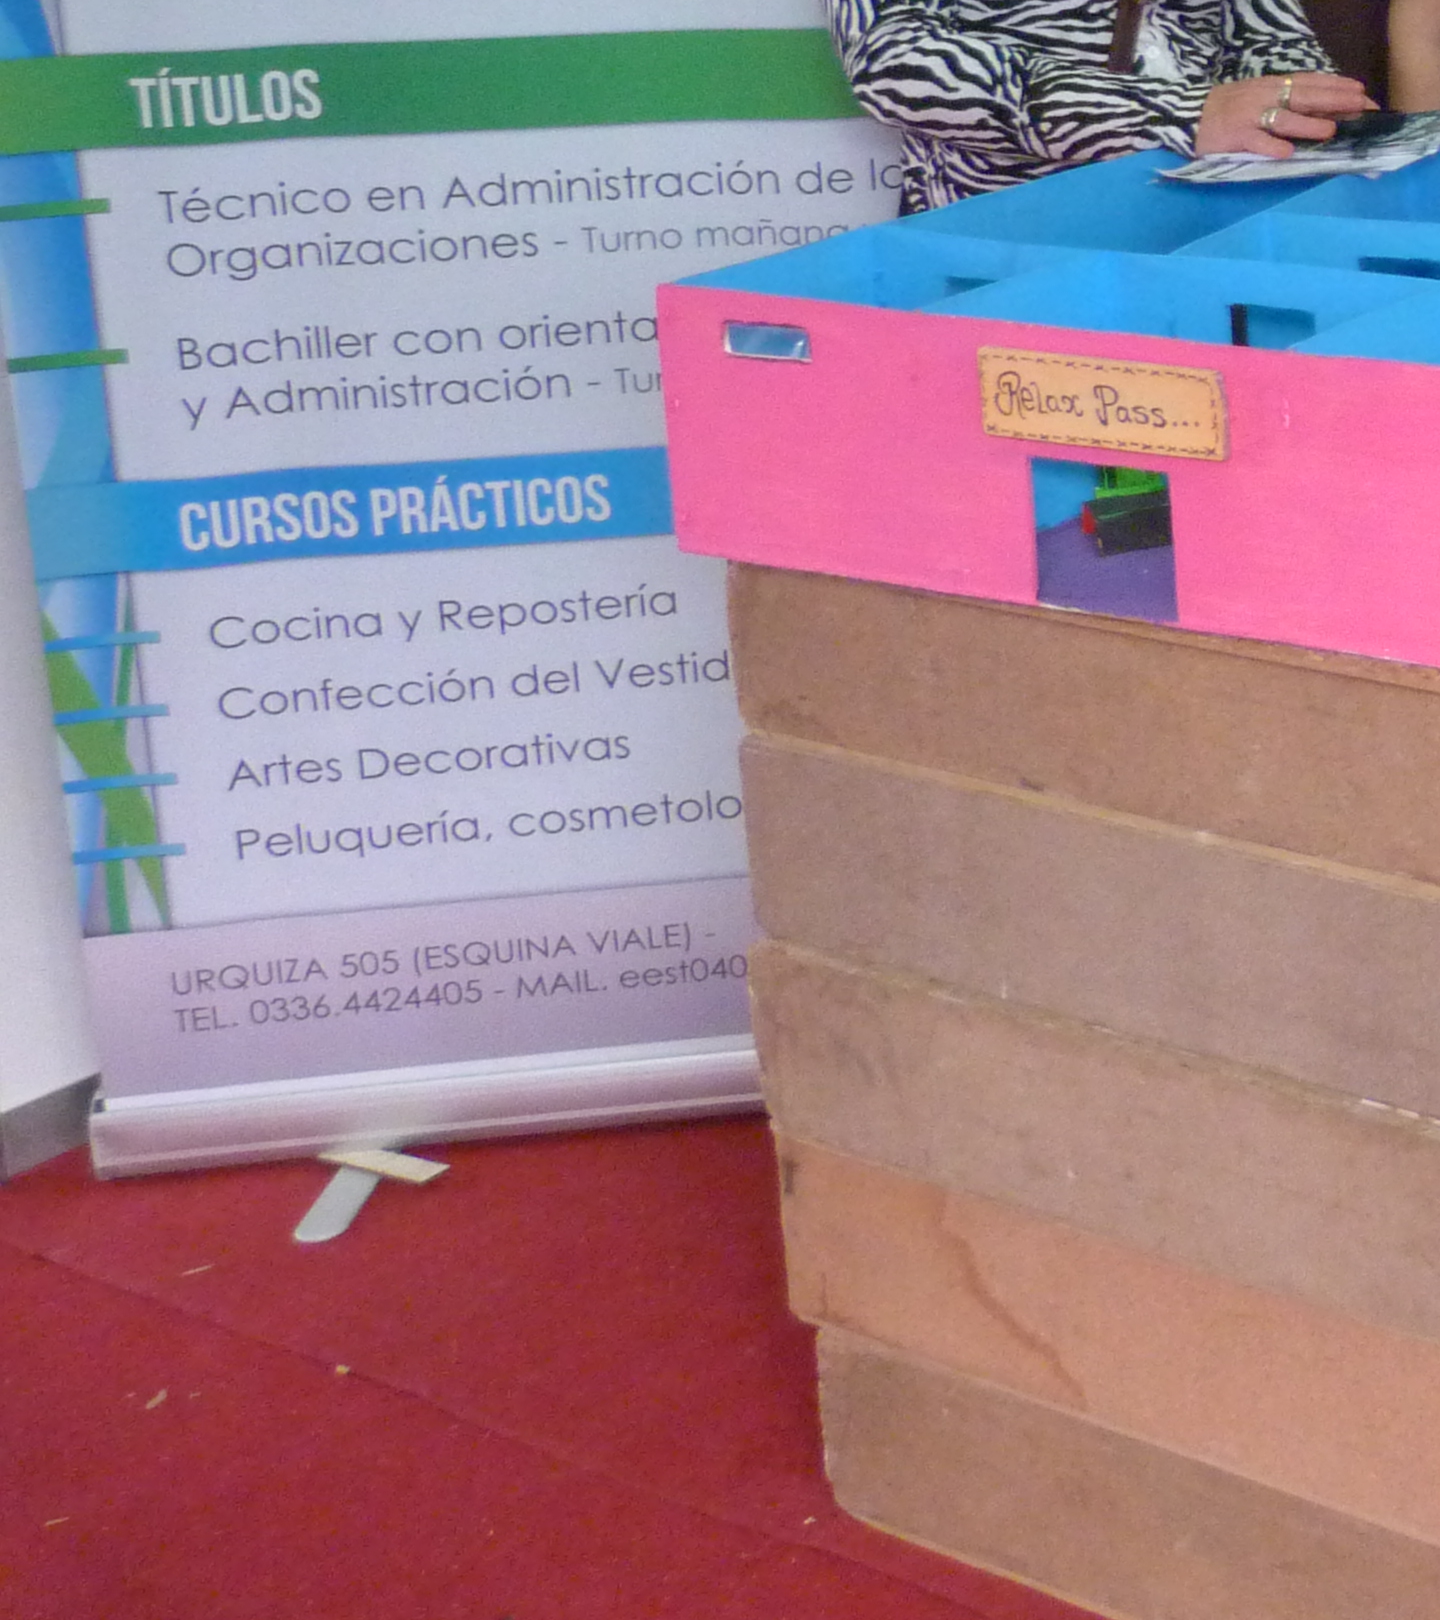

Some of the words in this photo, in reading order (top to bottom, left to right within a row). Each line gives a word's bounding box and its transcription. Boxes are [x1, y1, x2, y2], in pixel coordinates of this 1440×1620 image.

[129, 68, 323, 129] TÍTULOS
[157, 184, 352, 225] Técnico
[366, 183, 426, 212] en
[441, 159, 785, 210] Administración
[795, 161, 854, 195] de
[166, 226, 539, 281] Organizaciones
[581, 224, 683, 254] Turno
[176, 322, 376, 371] Bachiller
[393, 326, 483, 358] con
[498, 310, 659, 350] orienta
[181, 394, 208, 429] y
[225, 365, 572, 422] Administración
[994, 370, 1084, 420] Relax
[178, 487, 360, 552] CURSOS
[371, 475, 612, 537] PRÁCTICOS
[209, 605, 384, 650] Cocina
[397, 608, 423, 643] y
[438, 580, 678, 633] Repostería
[218, 667, 496, 722] Confección
[511, 661, 582, 698] del
[595, 650, 731, 690] Vestid
[228, 755, 343, 792] Artes
[358, 730, 631, 781] Decorativas
[235, 810, 494, 862] Peluquería,
[508, 789, 743, 837] cosmetolo
[171, 956, 328, 997] URQUIZA
[340, 948, 400, 980] 505
[413, 931, 576, 977] (ESQUINA
[588, 921, 693, 955] VIALE)
[173, 1005, 239, 1035] TEL.
[249, 977, 483, 1028] 0336.4424405
[517, 968, 608, 1000] MAIL.
[619, 952, 748, 990] eest040
